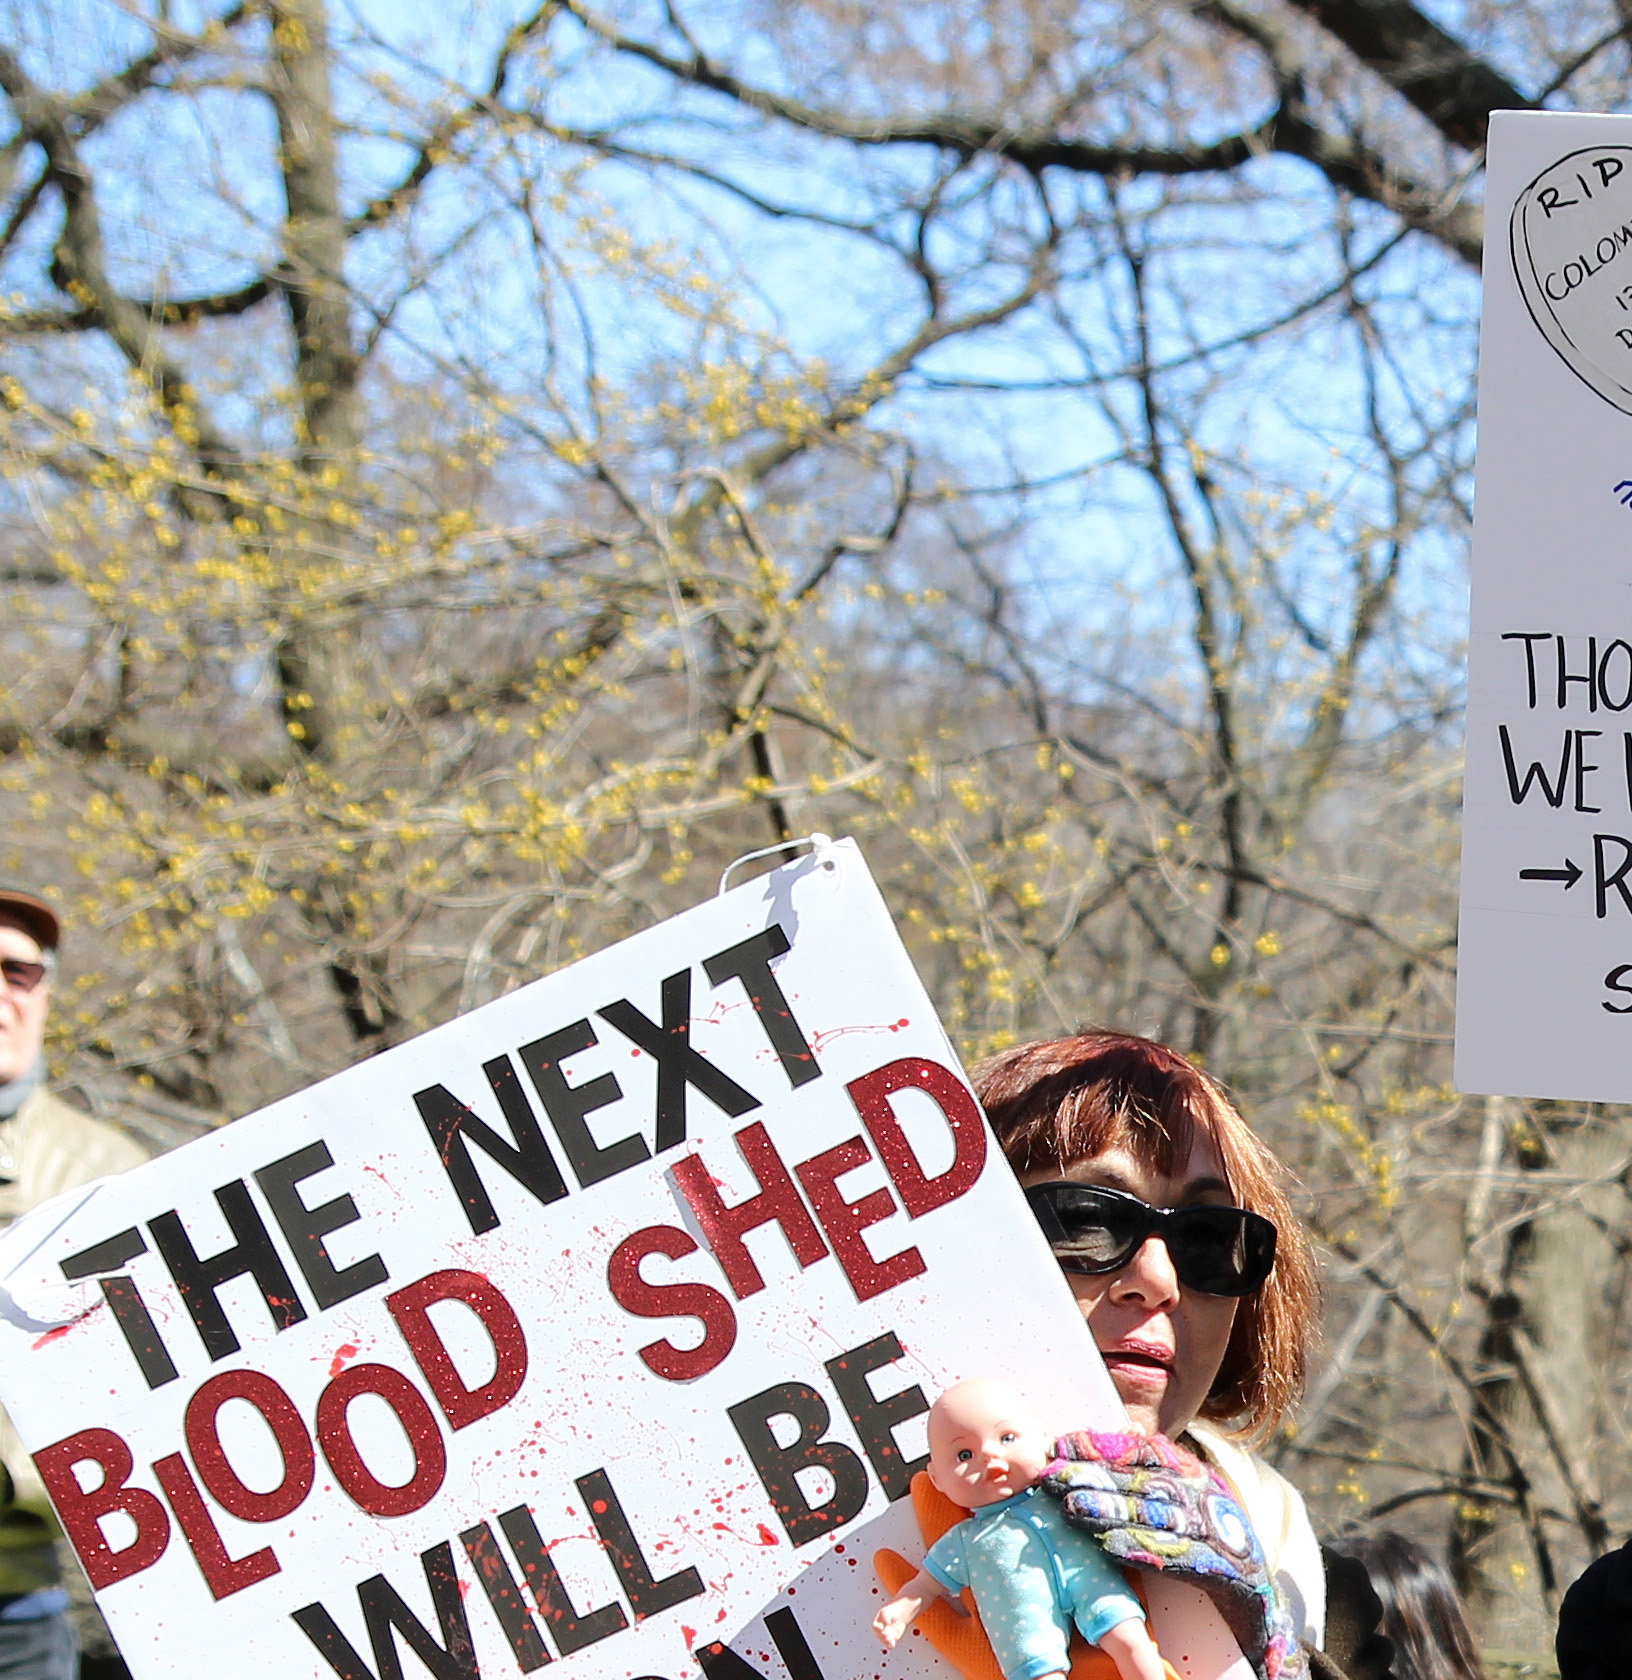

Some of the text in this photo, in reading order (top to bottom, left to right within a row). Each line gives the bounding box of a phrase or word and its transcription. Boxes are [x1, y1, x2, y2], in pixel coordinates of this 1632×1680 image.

[1537, 157, 1623, 217] RIP
[1499, 725, 1601, 812] WE
[60, 923, 823, 1391] THE NEXT
[31, 1054, 988, 1602] BLOOD SHED
[726, 1330, 931, 1548] BE
